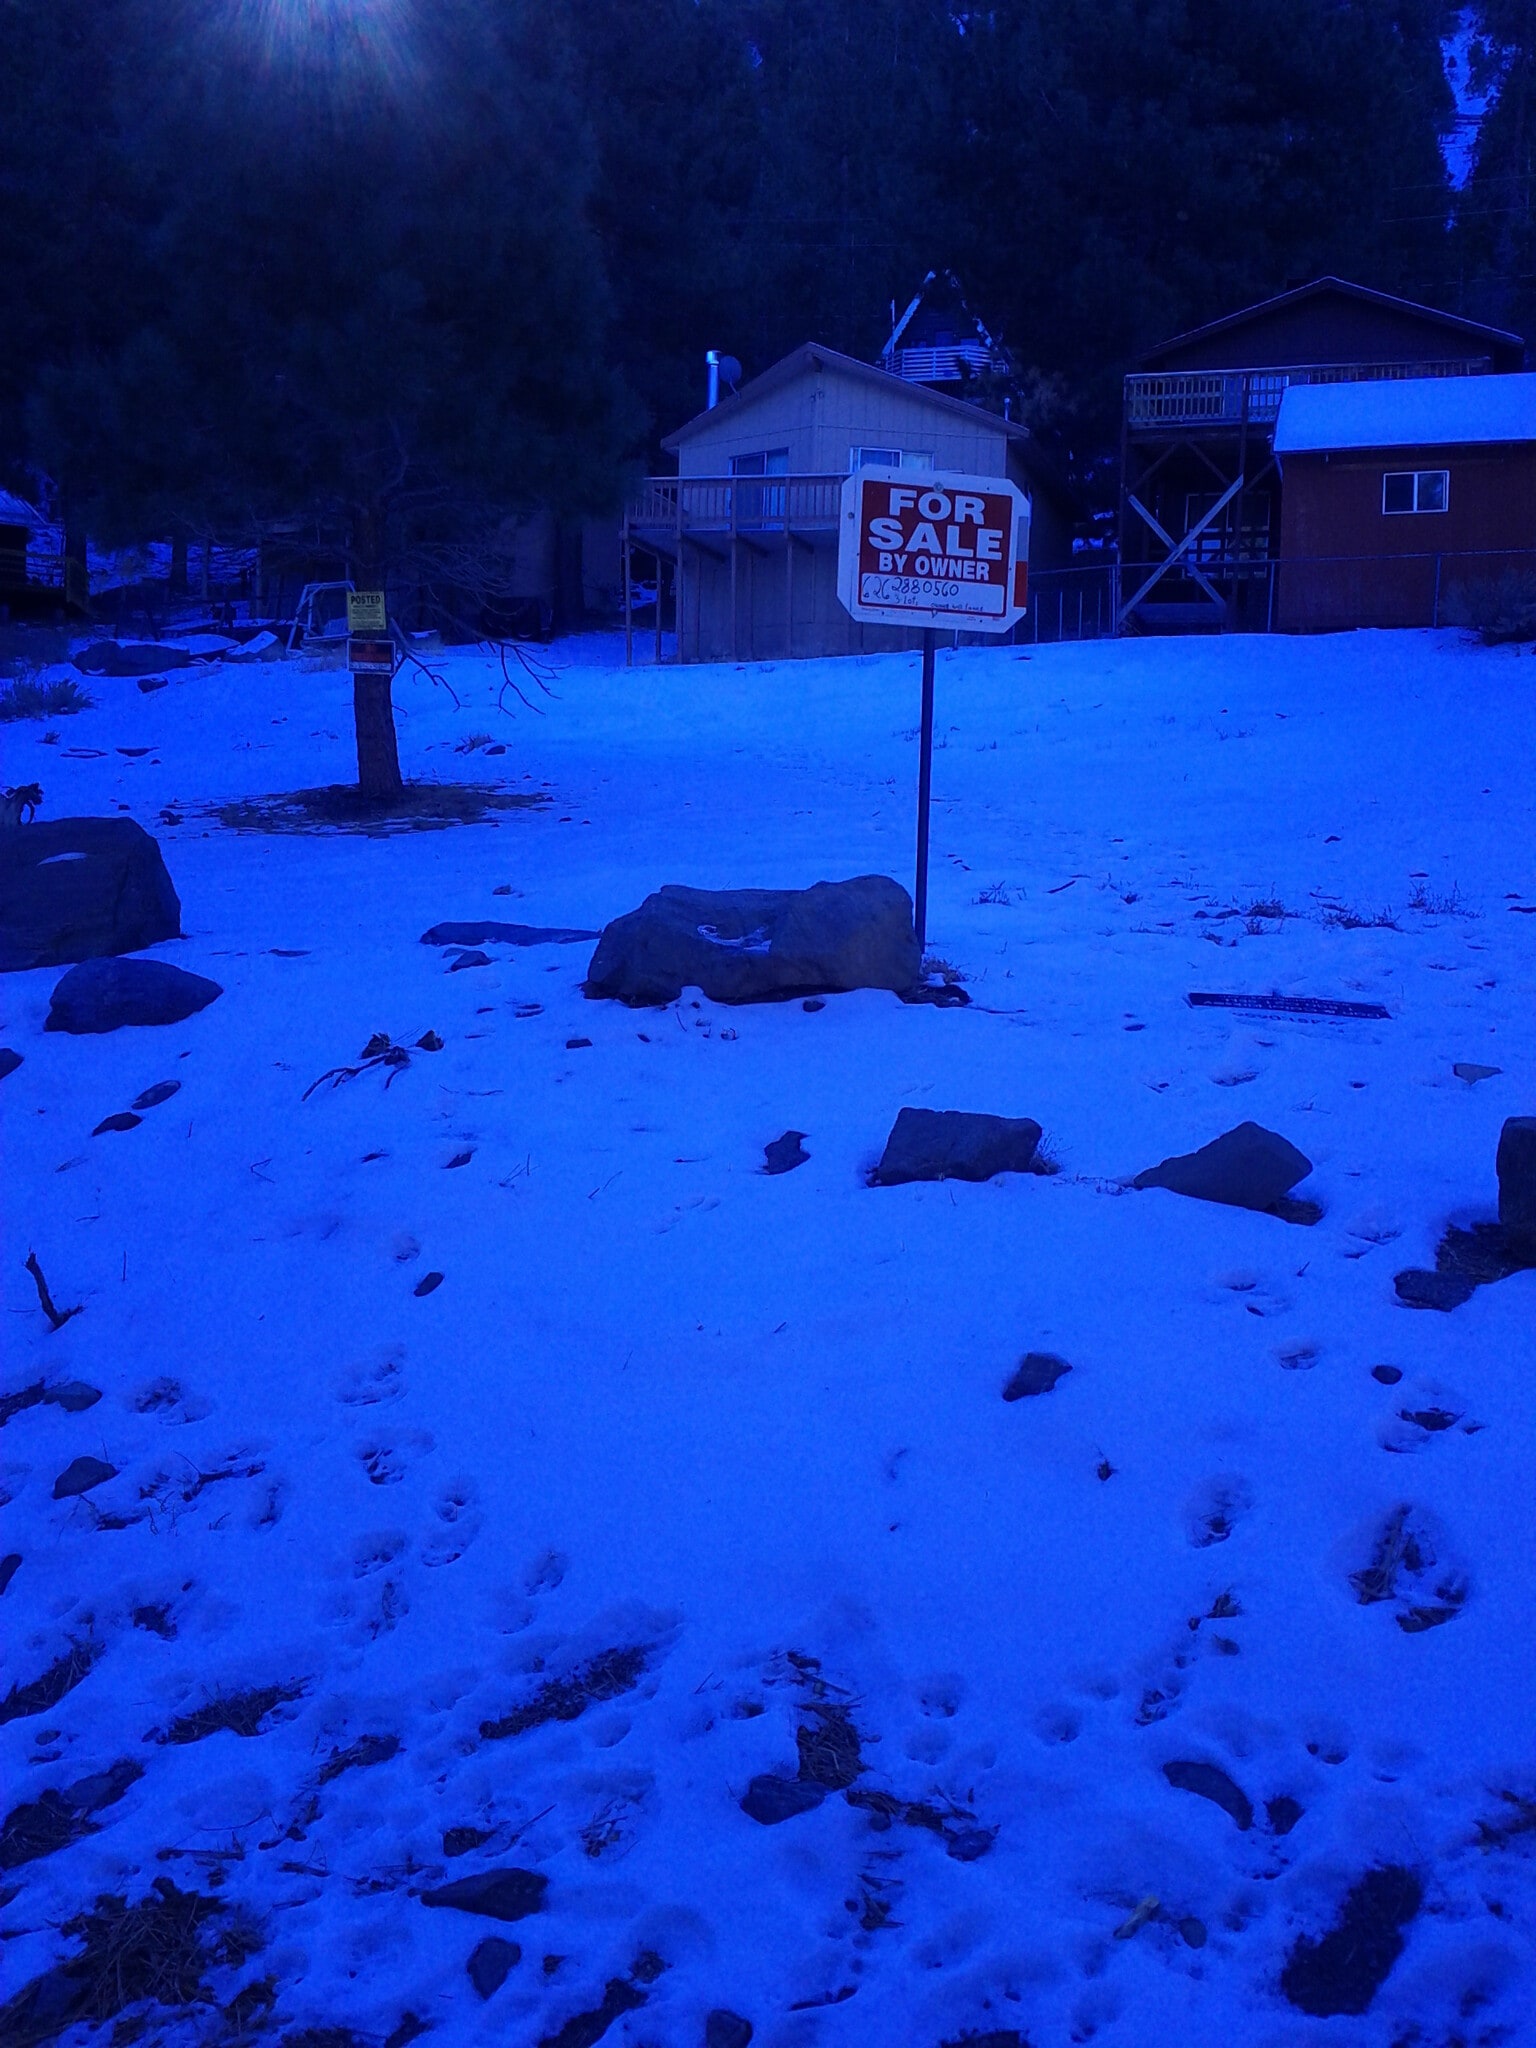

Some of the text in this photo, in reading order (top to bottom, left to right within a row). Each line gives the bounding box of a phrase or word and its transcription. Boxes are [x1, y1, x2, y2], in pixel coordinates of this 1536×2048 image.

[888, 487, 986, 526] FOR
[868, 517, 1004, 561] SALE
[878, 552, 990, 581] BY OWNER
[350, 595, 381, 605] POSTED
